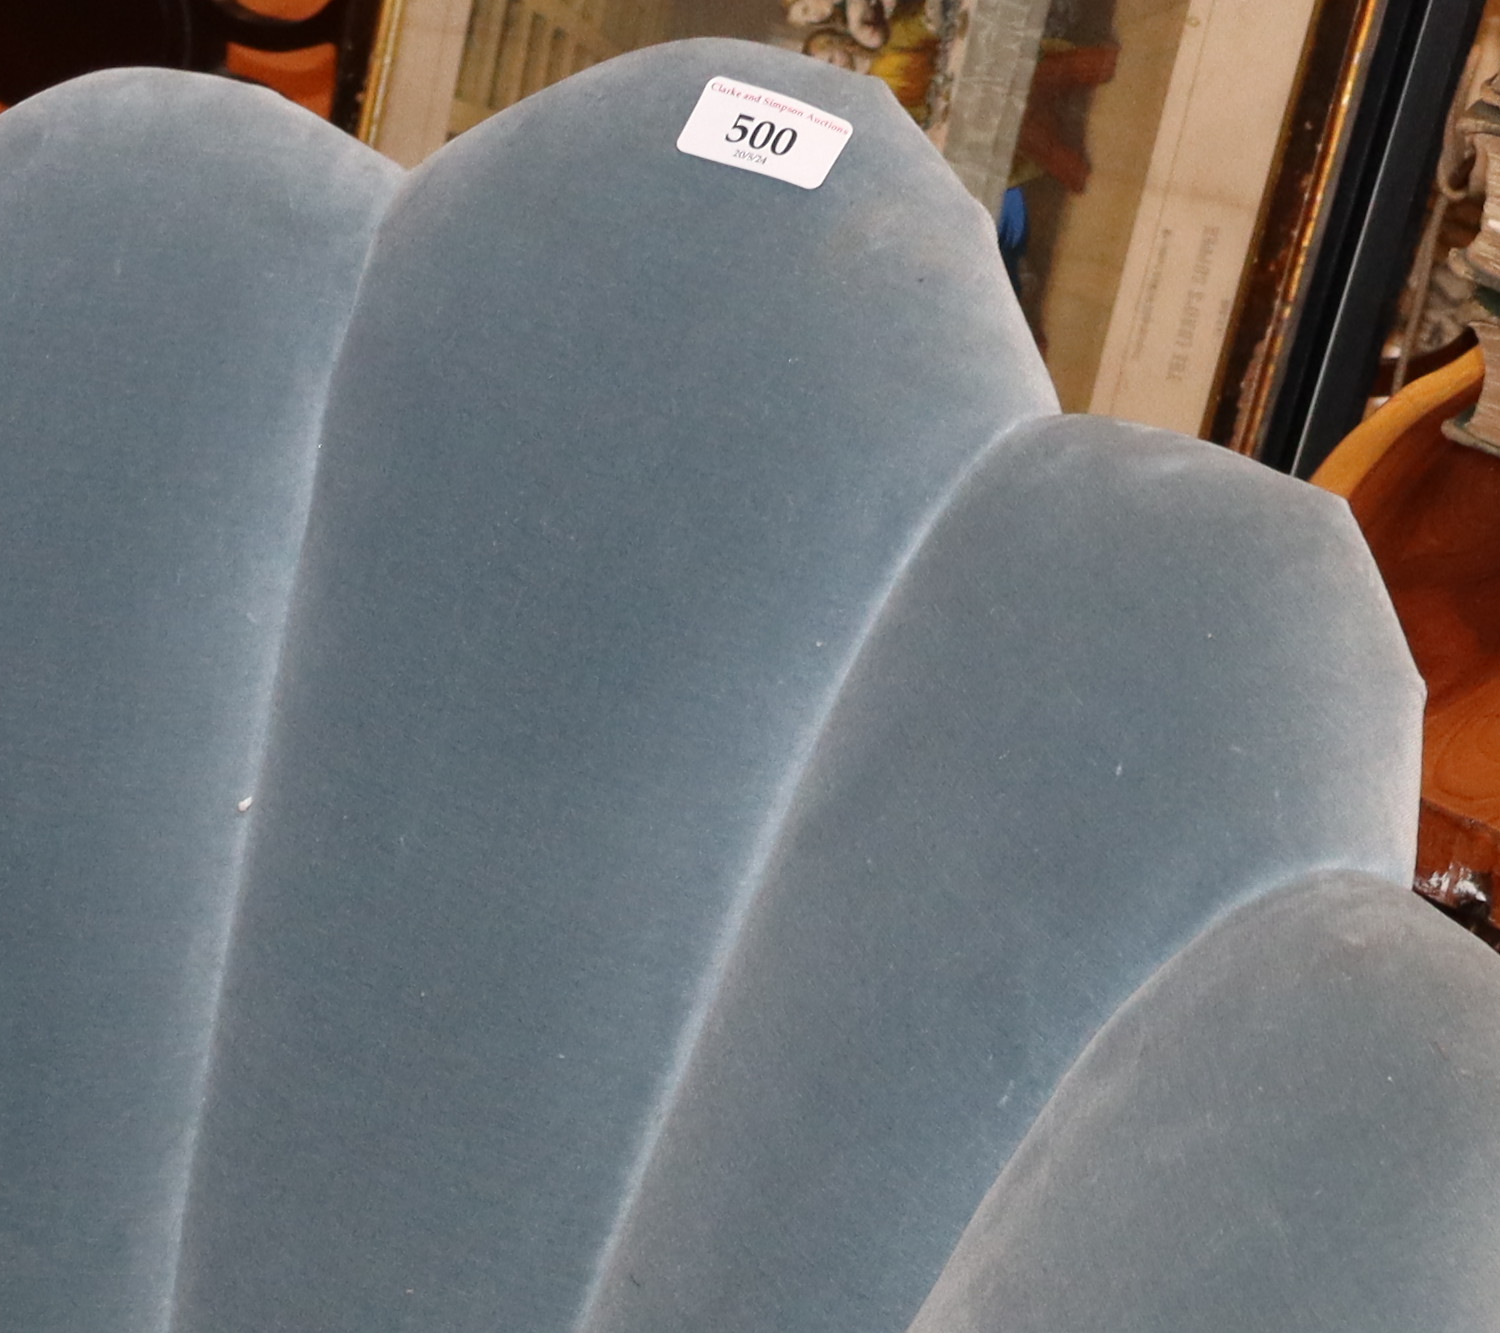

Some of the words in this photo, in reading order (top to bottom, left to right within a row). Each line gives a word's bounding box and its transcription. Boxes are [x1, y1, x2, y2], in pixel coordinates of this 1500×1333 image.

[711, 82, 743, 99] Clarke
[743, 92, 762, 104] and
[763, 97, 804, 118] Simpson
[807, 113, 849, 136] Auctions
[725, 114, 798, 156] 500
